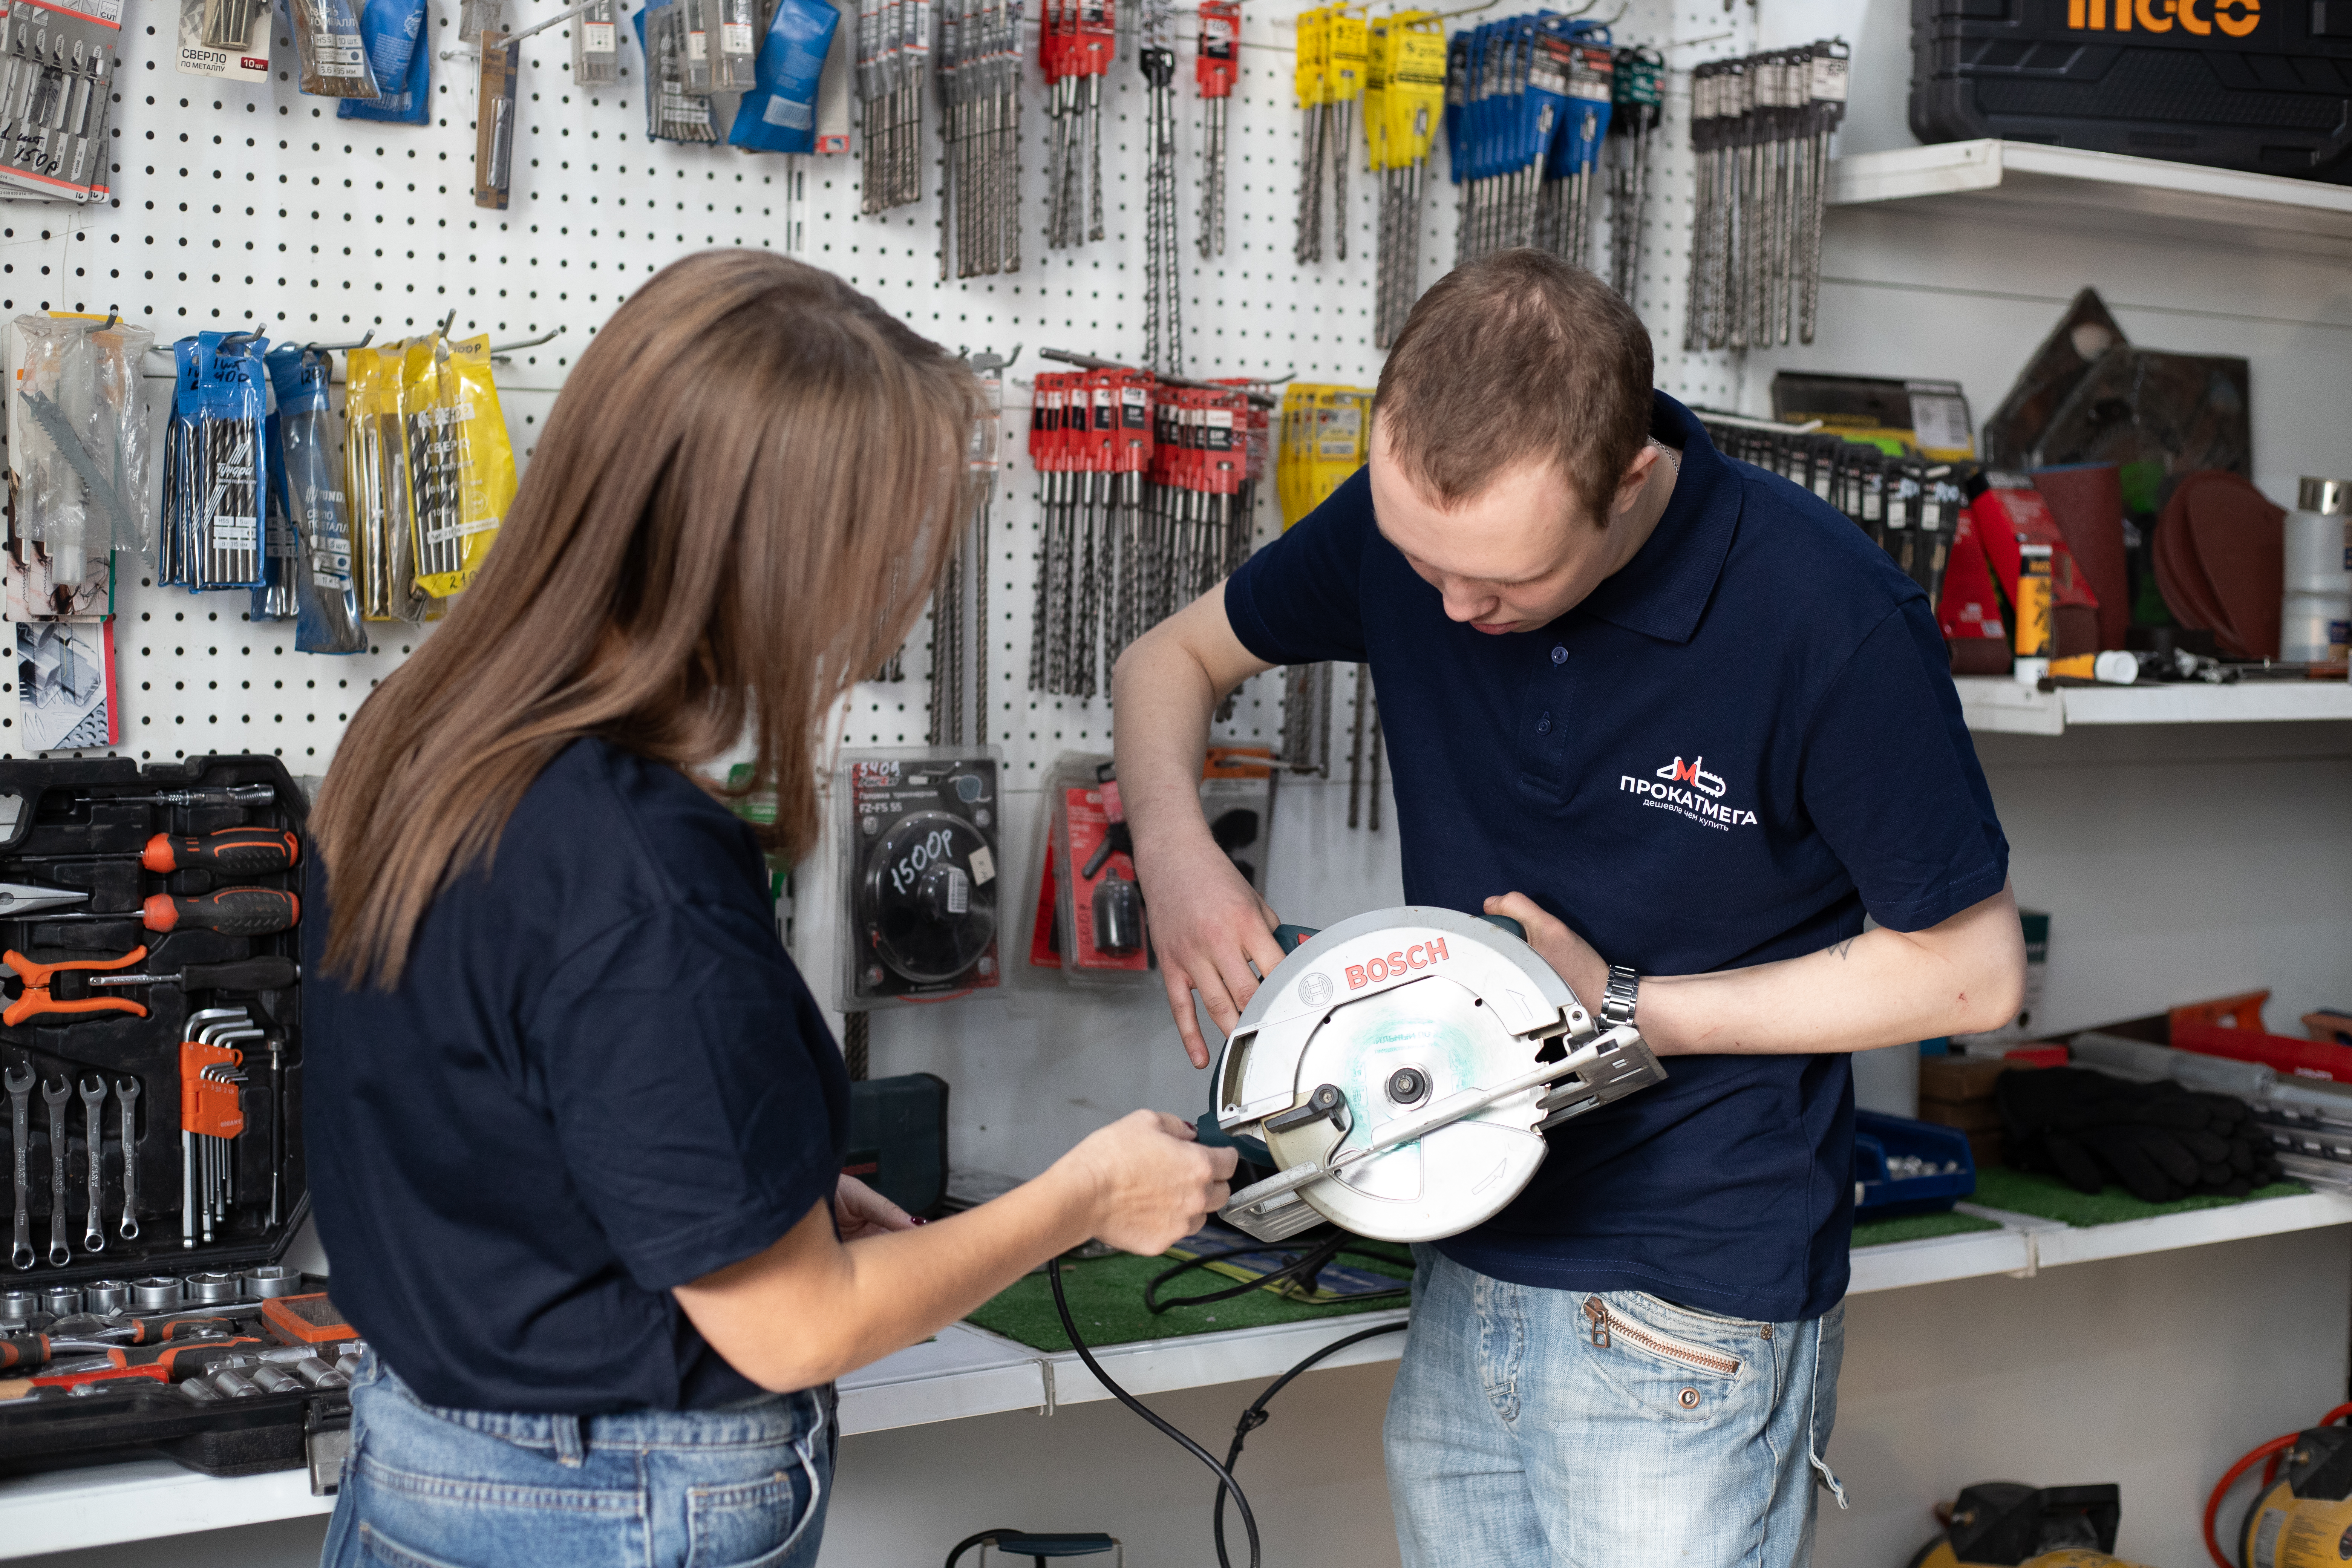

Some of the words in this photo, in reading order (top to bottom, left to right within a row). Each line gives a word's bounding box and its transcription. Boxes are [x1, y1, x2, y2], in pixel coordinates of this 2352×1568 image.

[101, 12, 116, 20] CUT
[182, 49, 226, 63] СВЕРЛО
[192, 62, 225, 72] МЕТАЛЛУ
[243, 59, 255, 68] 10
[1620, 775, 1758, 825] ПРОКАТМЕГА
[1643, 799, 1683, 814] дешевле
[1684, 811, 1698, 821] чем
[1699, 817, 1729, 831] купить
[1345, 937, 1449, 991] BOSCH
[1374, 1032, 1416, 1045] ИЛЬНЫЙ
